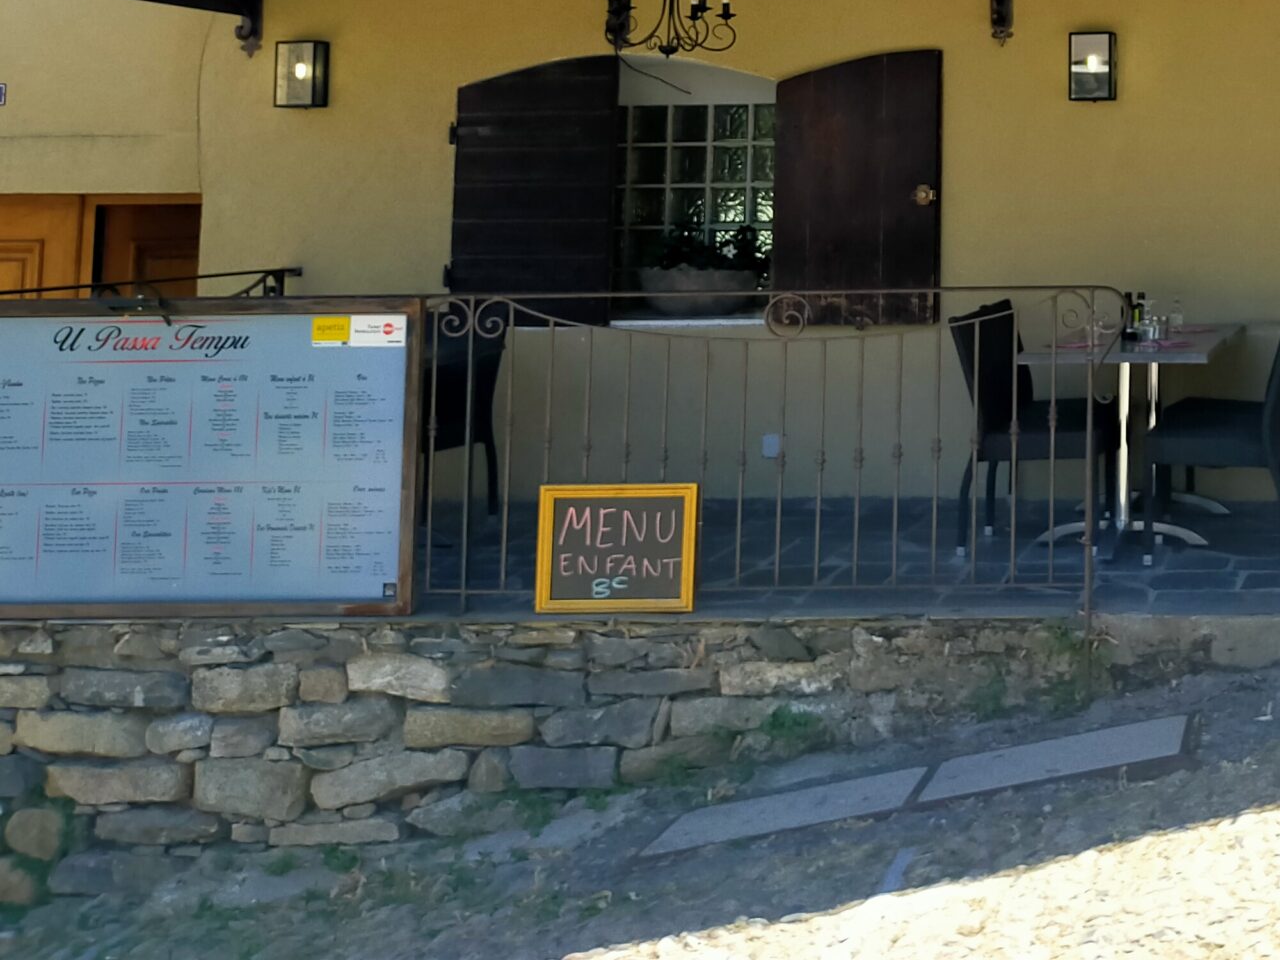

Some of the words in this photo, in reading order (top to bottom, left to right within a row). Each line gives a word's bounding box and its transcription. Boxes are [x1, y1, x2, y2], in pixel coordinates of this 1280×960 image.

[54, 325, 86, 352] U
[87, 325, 162, 352] Passa
[169, 324, 250, 359] Tempu
[559, 506, 676, 548] MENU
[560, 553, 682, 579] ENFANT
